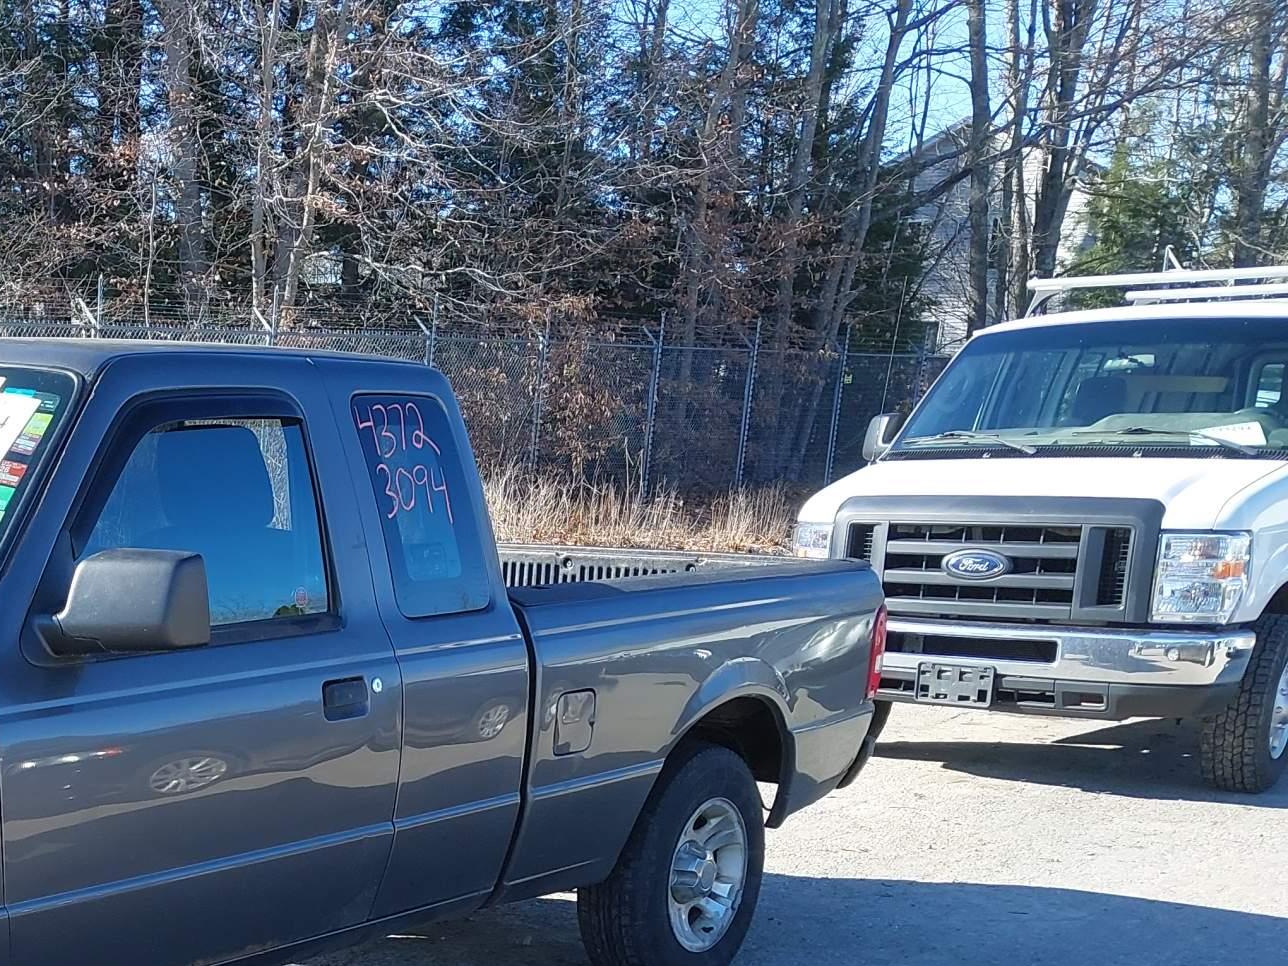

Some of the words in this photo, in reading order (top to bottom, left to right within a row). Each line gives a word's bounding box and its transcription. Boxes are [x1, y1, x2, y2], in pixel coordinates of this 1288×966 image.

[353, 402, 441, 458] 4372
[376, 463, 454, 524] 3094
[958, 557, 990, 572] Ford
